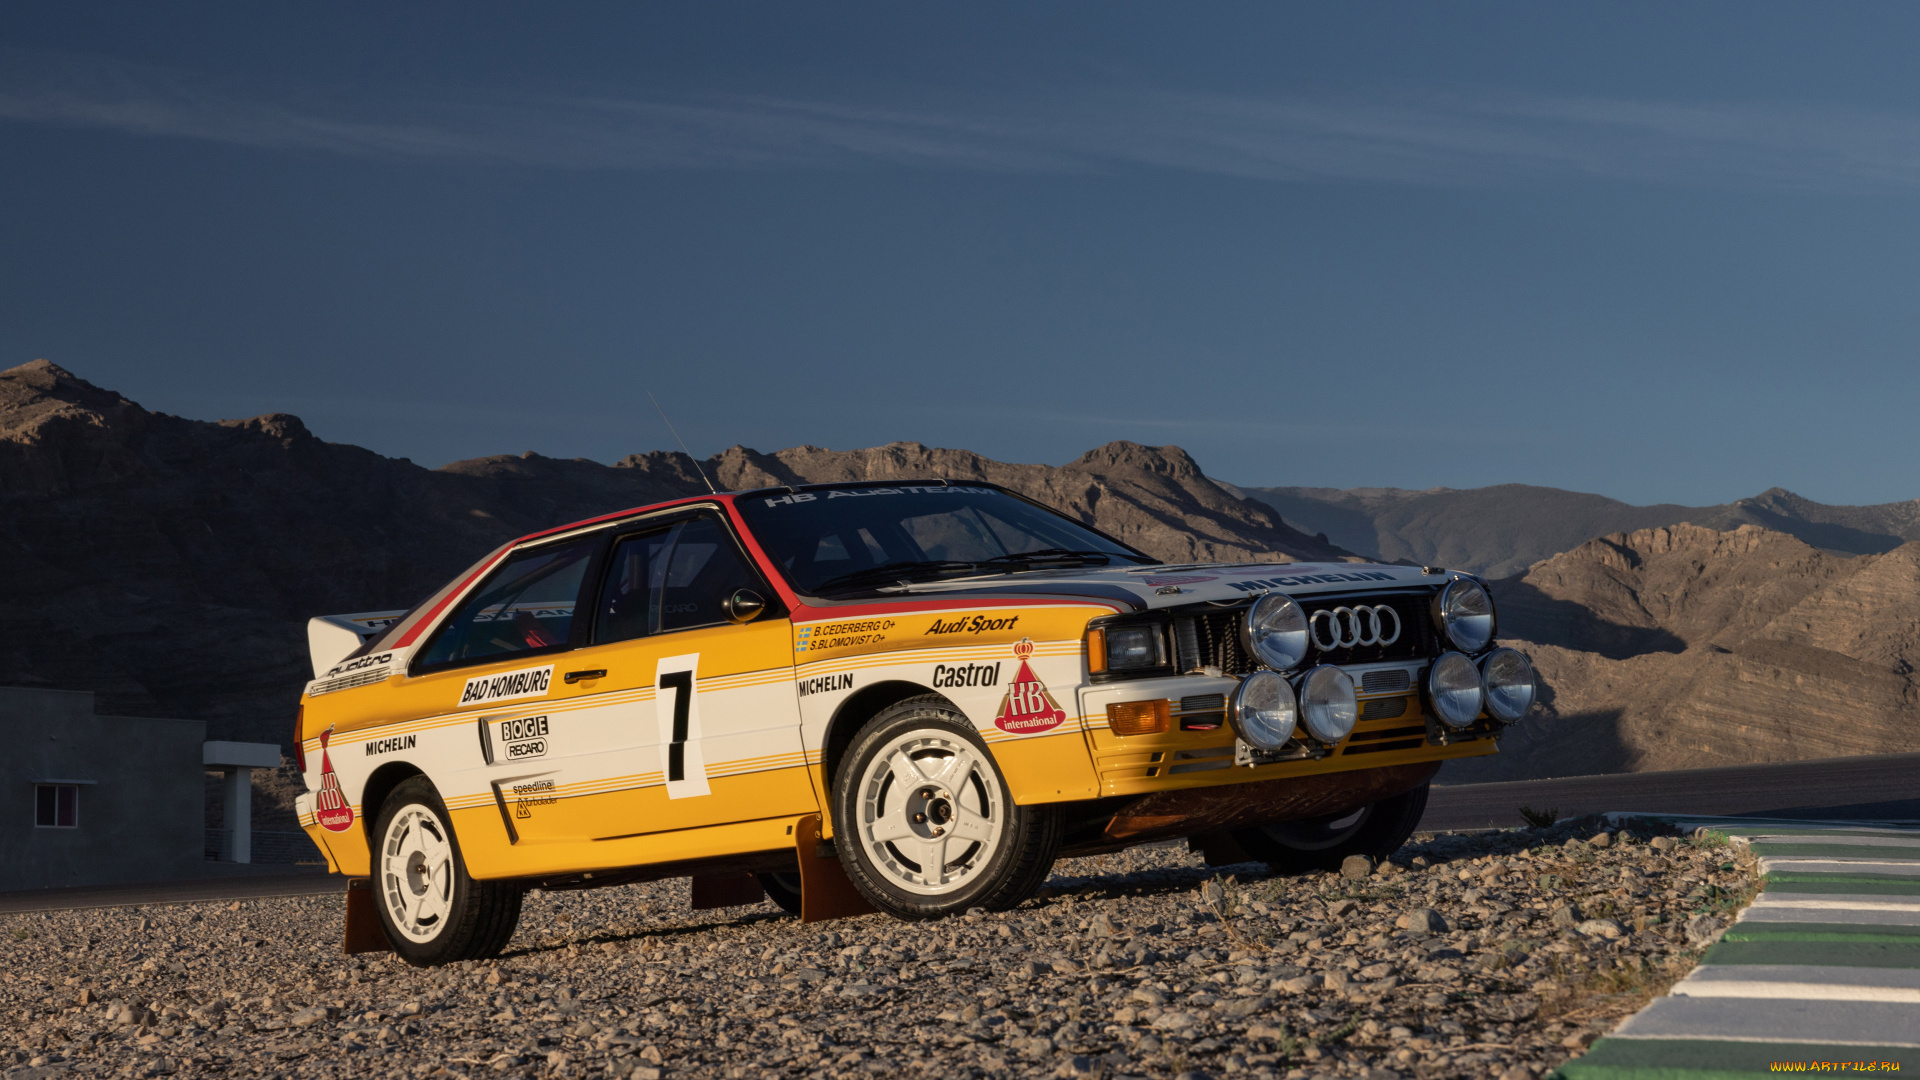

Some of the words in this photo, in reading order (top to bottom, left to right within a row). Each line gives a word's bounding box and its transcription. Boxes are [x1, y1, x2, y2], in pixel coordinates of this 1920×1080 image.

[764, 493, 818, 508] HB
[899, 486, 997, 496] TEAM
[1225, 572, 1397, 592] MICHELIN
[651, 602, 699, 614] RCARO
[813, 621, 881, 637] B.CEDERBERG
[924, 616, 971, 636] Audi
[967, 615, 1020, 635] Sport
[810, 634, 872, 651] S.BLOMQVIST
[328, 653, 393, 678] quattro
[932, 661, 1001, 688] Castrol
[461, 679, 489, 703] BAD
[487, 668, 551, 699] HOMBURG
[799, 673, 853, 698] MICHELIN
[1008, 680, 1046, 717] HB
[502, 716, 549, 741] BOGE
[659, 669, 693, 782] 7
[1003, 713, 1058, 730] international
[366, 734, 417, 757] MICHELIN
[509, 741, 545, 757] RECARO
[513, 780, 553, 796] speedline
[524, 795, 558, 807] Turbolader
